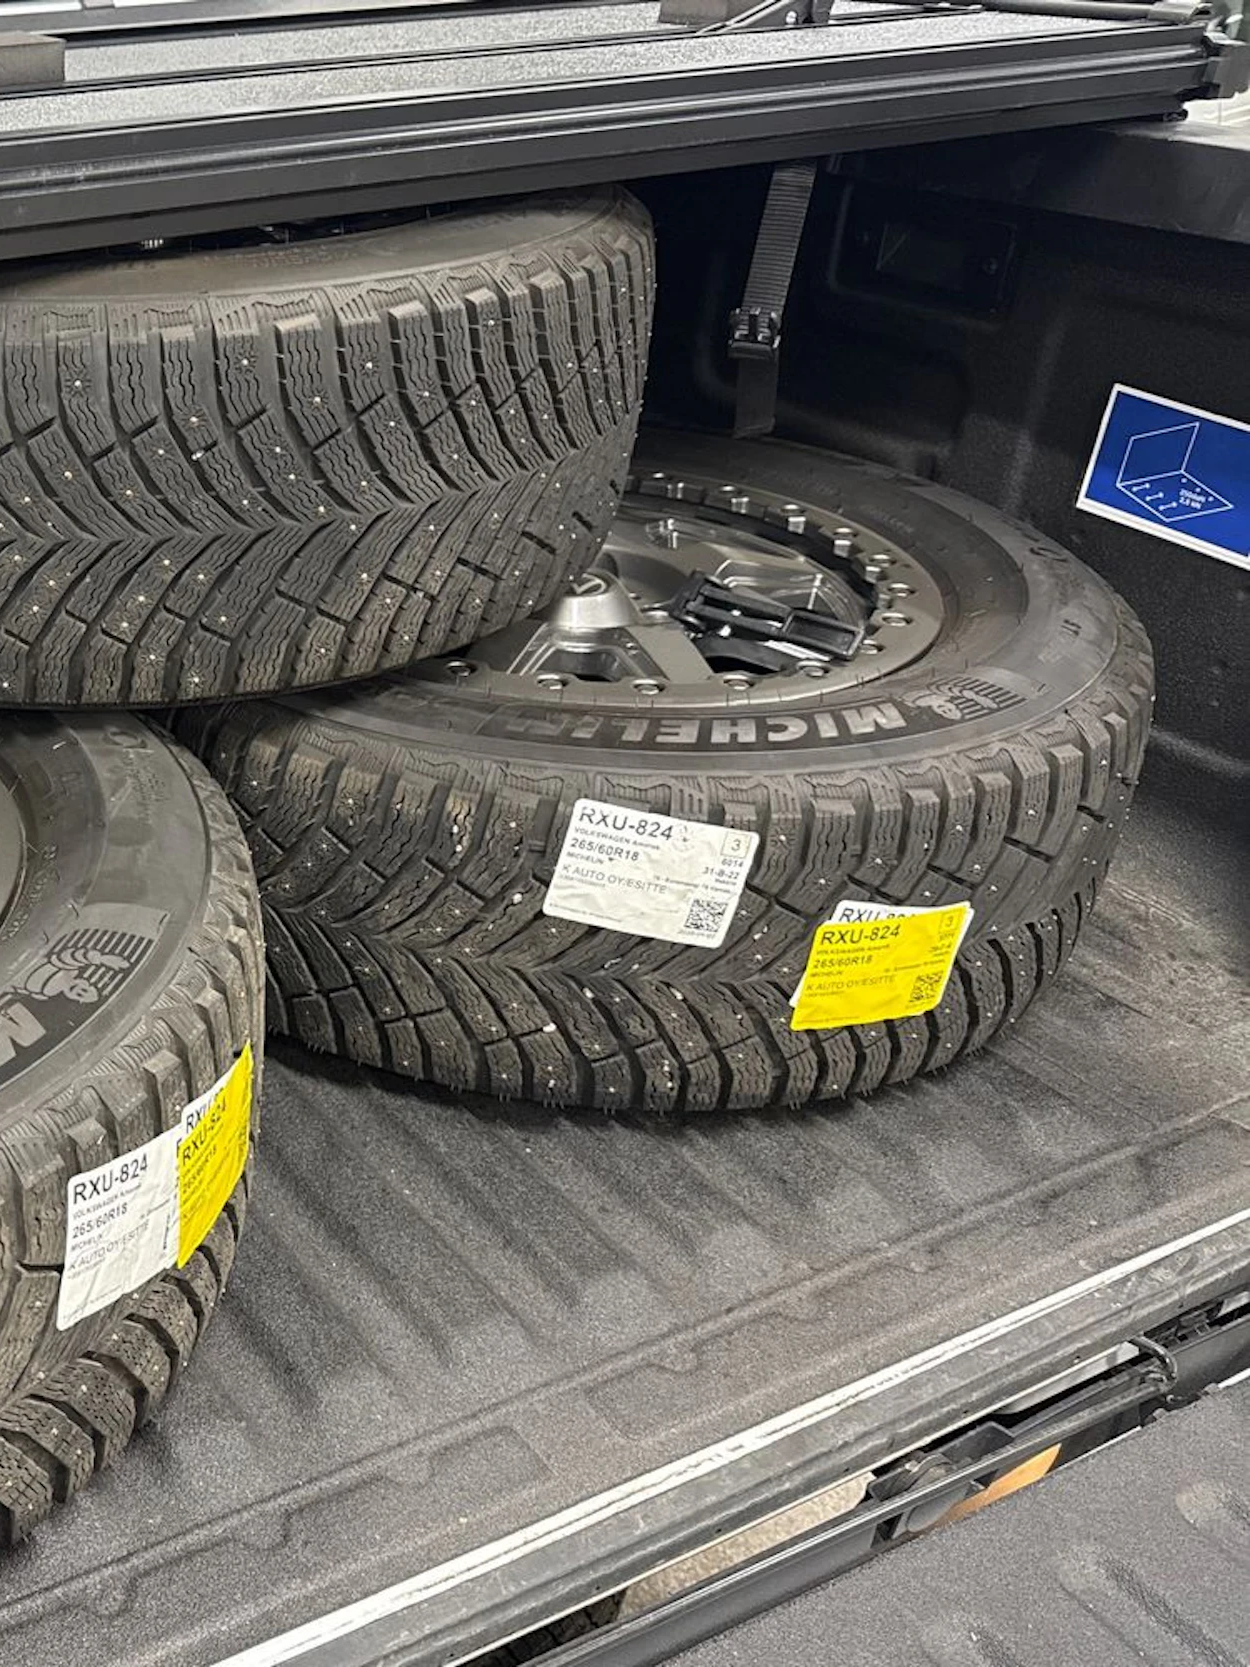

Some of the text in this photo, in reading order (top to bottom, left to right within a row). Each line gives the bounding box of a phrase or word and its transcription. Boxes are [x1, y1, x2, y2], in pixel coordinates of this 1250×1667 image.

[578, 807, 675, 840] RXU-824
[570, 838, 639, 861] 265/60R18
[729, 838, 743, 852] 3
[571, 866, 606, 881] AUTO
[821, 924, 901, 945] RXU-824
[813, 955, 873, 969] 265/60R18
[73, 1152, 148, 1205] RXU-824
[72, 1202, 128, 1240] 265/60R18
